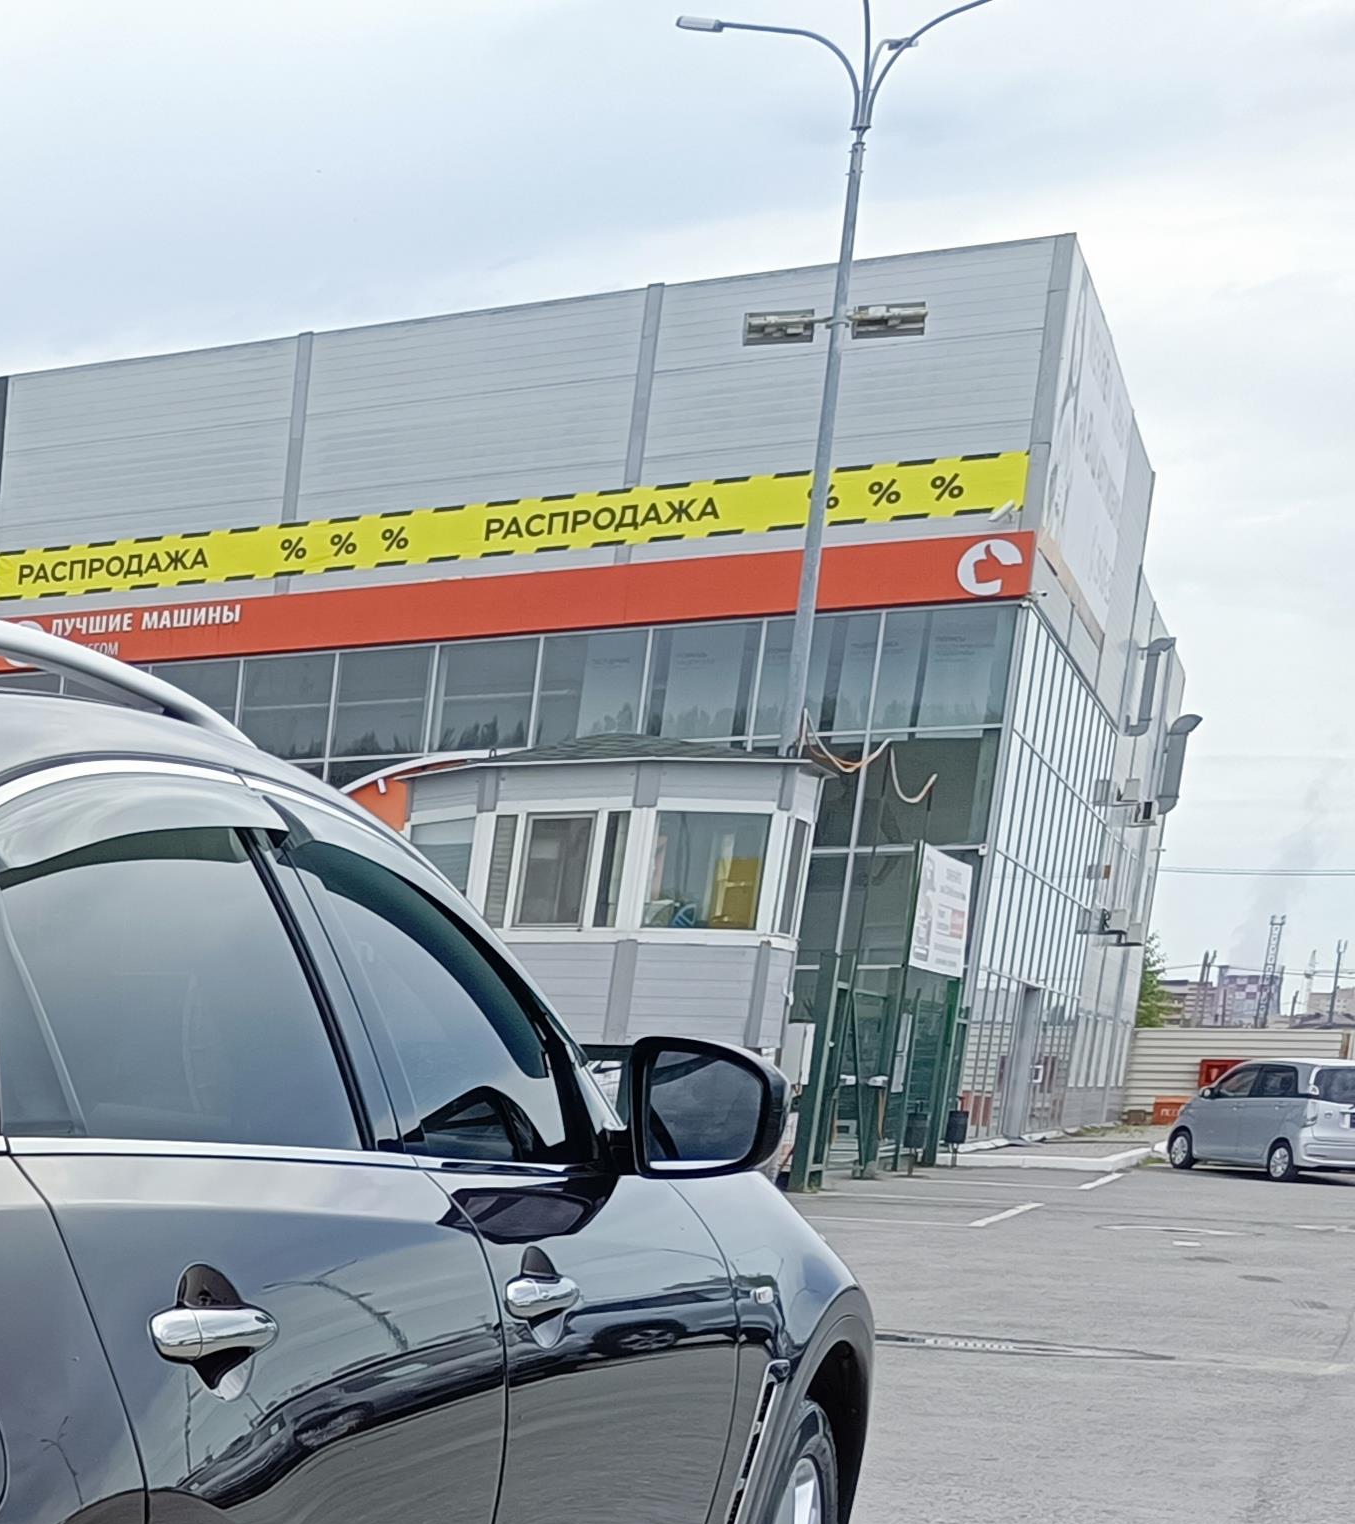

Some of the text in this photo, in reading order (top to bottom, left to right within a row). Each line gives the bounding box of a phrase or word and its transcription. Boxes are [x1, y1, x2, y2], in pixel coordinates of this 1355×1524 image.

[18, 547, 209, 586] РАСПРОДАЖА
[484, 497, 720, 542] РАСПРОДАЖА
[51, 604, 240, 636] ЛУЧШИЕ МАШИНЫ
